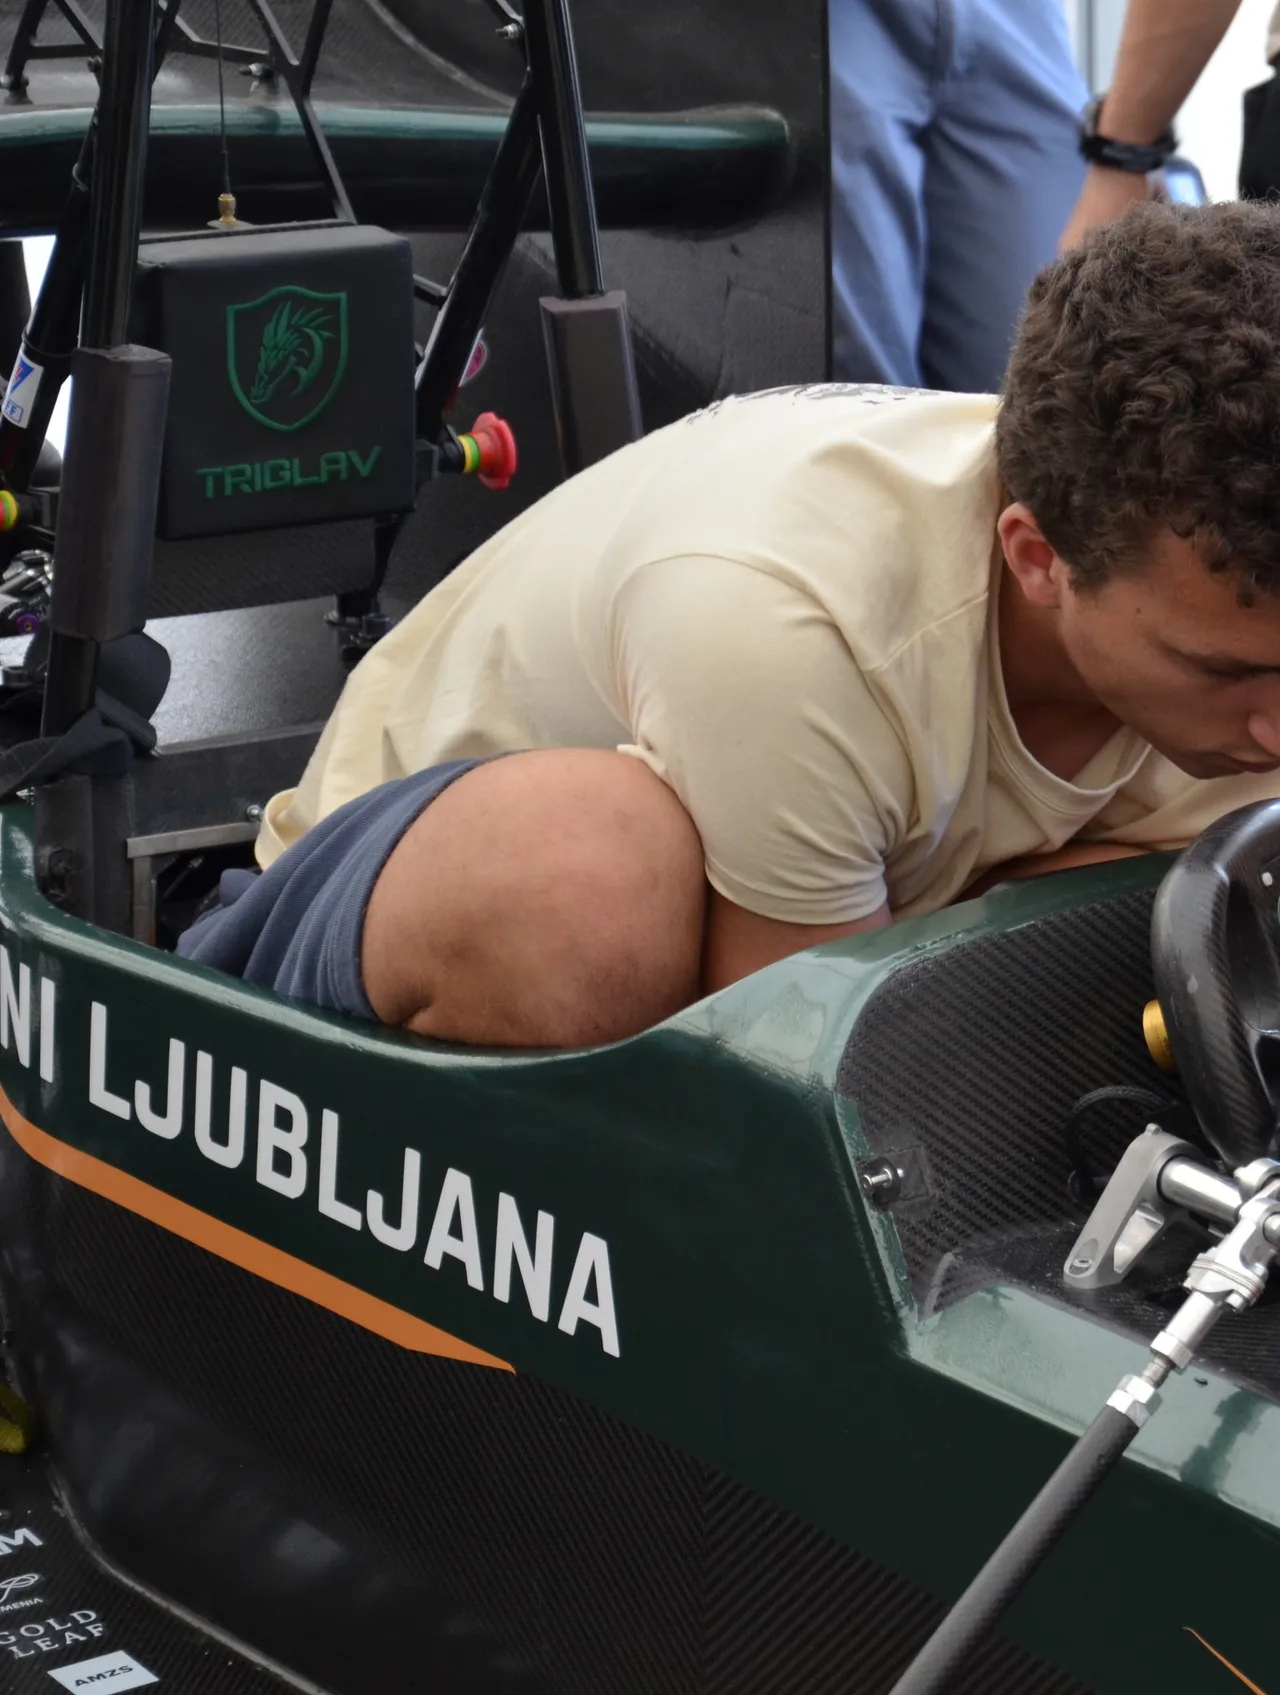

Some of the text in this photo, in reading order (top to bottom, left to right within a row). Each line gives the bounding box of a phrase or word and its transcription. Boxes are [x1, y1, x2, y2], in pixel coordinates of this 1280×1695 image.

[196, 445, 382, 498] TRIGLAV
[89, 1001, 620, 1358] LJUBLJANA
[0, 1610, 97, 1645] GOLD
[8, 1623, 104, 1659] LEAF
[75, 1665, 133, 1687] AMZS
